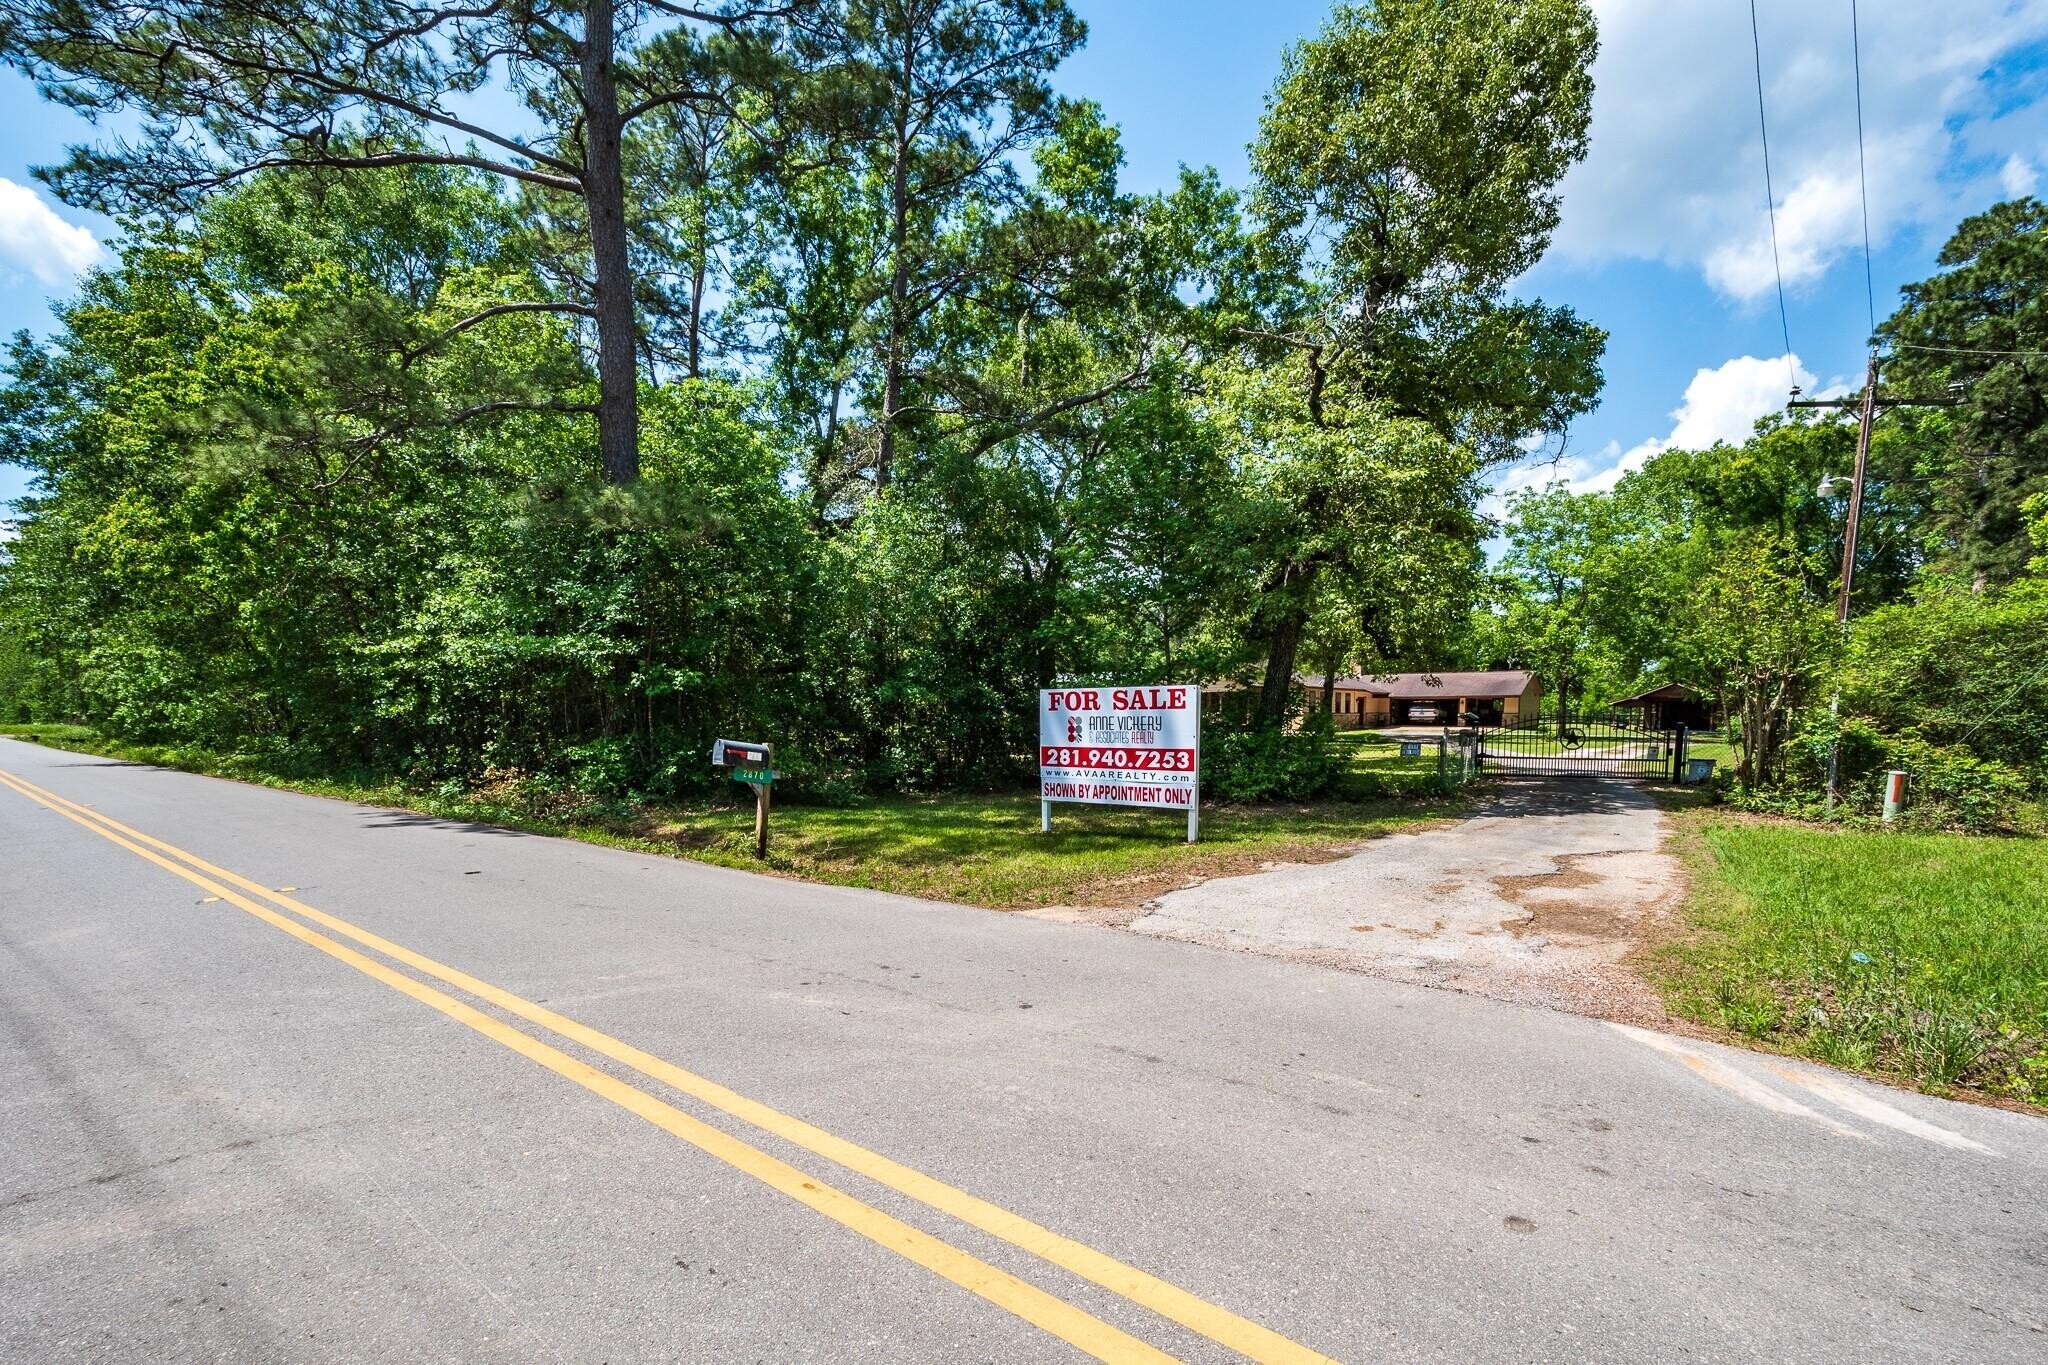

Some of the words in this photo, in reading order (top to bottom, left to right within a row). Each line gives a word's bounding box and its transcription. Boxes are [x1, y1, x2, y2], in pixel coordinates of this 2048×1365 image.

[1048, 691, 1100, 711] FOR
[1112, 688, 1187, 710] SALE
[1089, 716, 1114, 731] ANNE
[1117, 716, 1162, 731] VICKERY
[1131, 731, 1154, 744] REALTY
[1046, 749, 1190, 769] 281.940.7253
[1045, 770, 1189, 782] www.AVAAREALTY.com
[1044, 782, 1076, 798] SHOWN
[1079, 784, 1091, 799] BY
[1092, 784, 1162, 803] APPOINTMENT
[1164, 788, 1193, 804] ONLY
